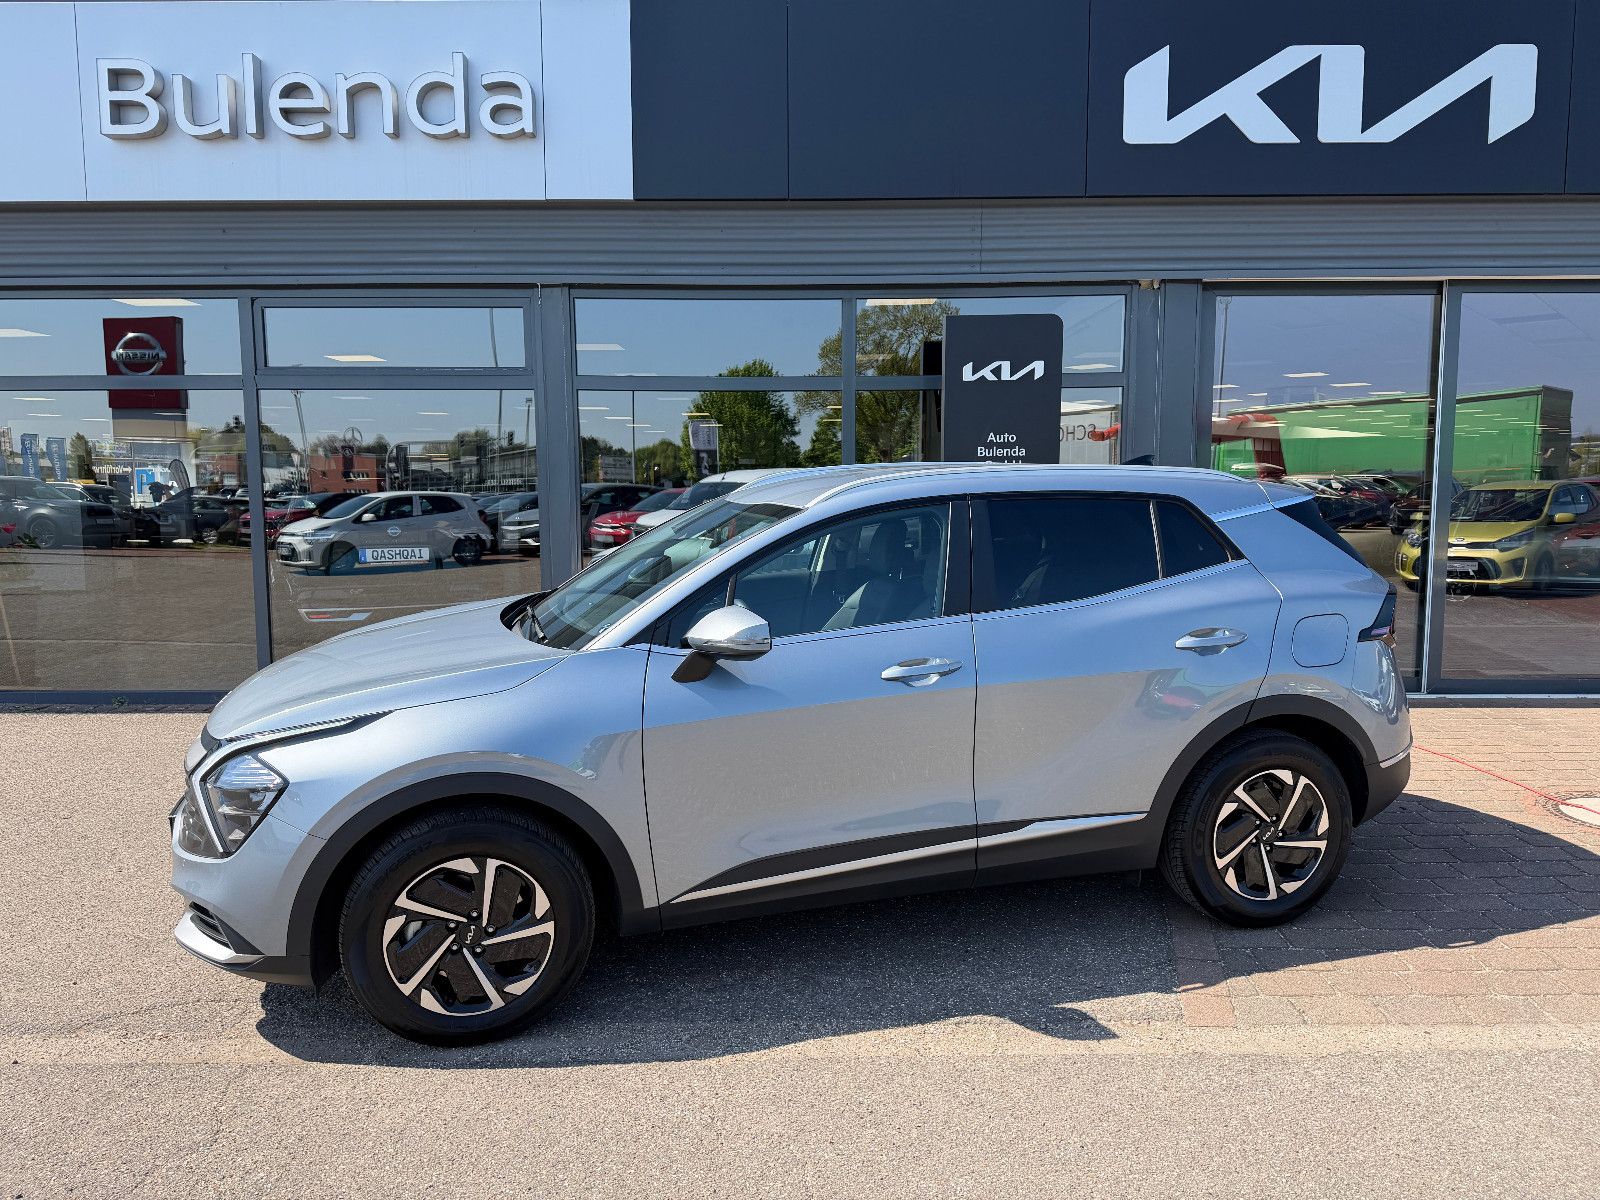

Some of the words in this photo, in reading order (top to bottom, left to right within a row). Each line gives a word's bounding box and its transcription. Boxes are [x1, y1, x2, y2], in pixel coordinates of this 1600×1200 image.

[96, 52, 537, 139] Bulenda
[1123, 43, 1538, 144] KIA
[962, 360, 1045, 382] KIA
[986, 432, 1017, 443] Auto
[977, 446, 1026, 457] Bulenda
[371, 548, 424, 561] QASHQAI
